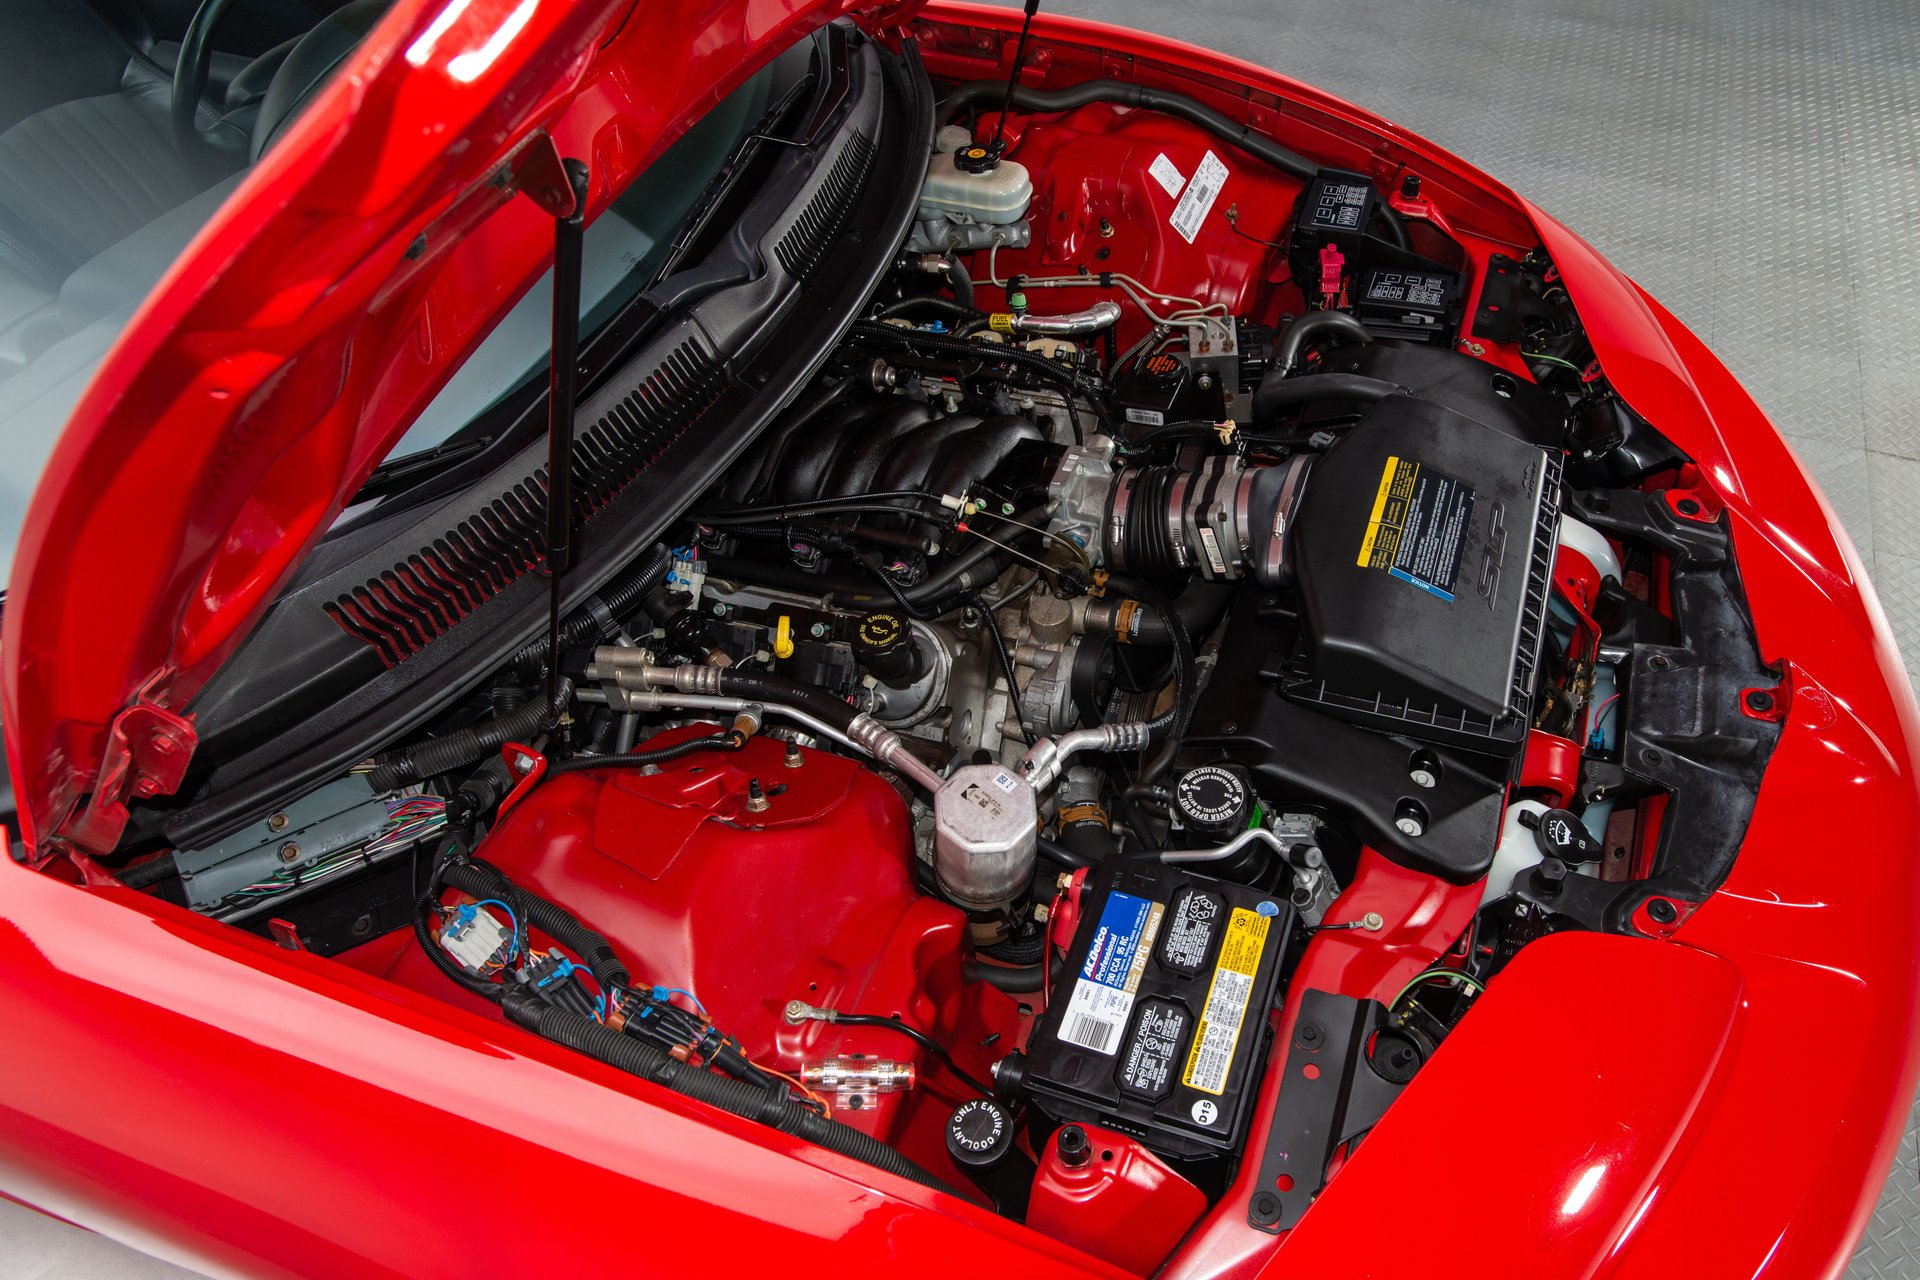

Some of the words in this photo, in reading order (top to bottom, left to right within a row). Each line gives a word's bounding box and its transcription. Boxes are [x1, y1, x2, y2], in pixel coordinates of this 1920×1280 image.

[1478, 501, 1508, 612] SLP
[1411, 577, 1430, 590] NOTICE
[867, 614, 895, 623] ENGINE
[1185, 770, 1198, 780] TUBE
[1210, 775, 1226, 784] CLOSED
[1216, 769, 1234, 780] ARROW
[1180, 798, 1191, 809] HOT
[1187, 791, 1197, 805] BOTTLE
[1217, 800, 1231, 811] CHECK
[1189, 808, 1208, 819] OPEN
[1210, 808, 1233, 819] NEVER
[1118, 934, 1129, 946] RC
[1083, 926, 1108, 977] ACDelco
[1094, 933, 1118, 981] Professional
[1115, 945, 1126, 956] 95
[1131, 944, 1150, 971] 75PG
[1111, 958, 1122, 973] CCA
[1105, 972, 1116, 985] 700
[1126, 1042, 1141, 1073] DANGER
[1137, 1008, 1152, 1036] POISON
[954, 1101, 978, 1123] ONLY
[981, 1101, 1002, 1136] ENGINE
[1198, 1101, 1212, 1124] D15
[952, 1126, 995, 1150] COOLANT
